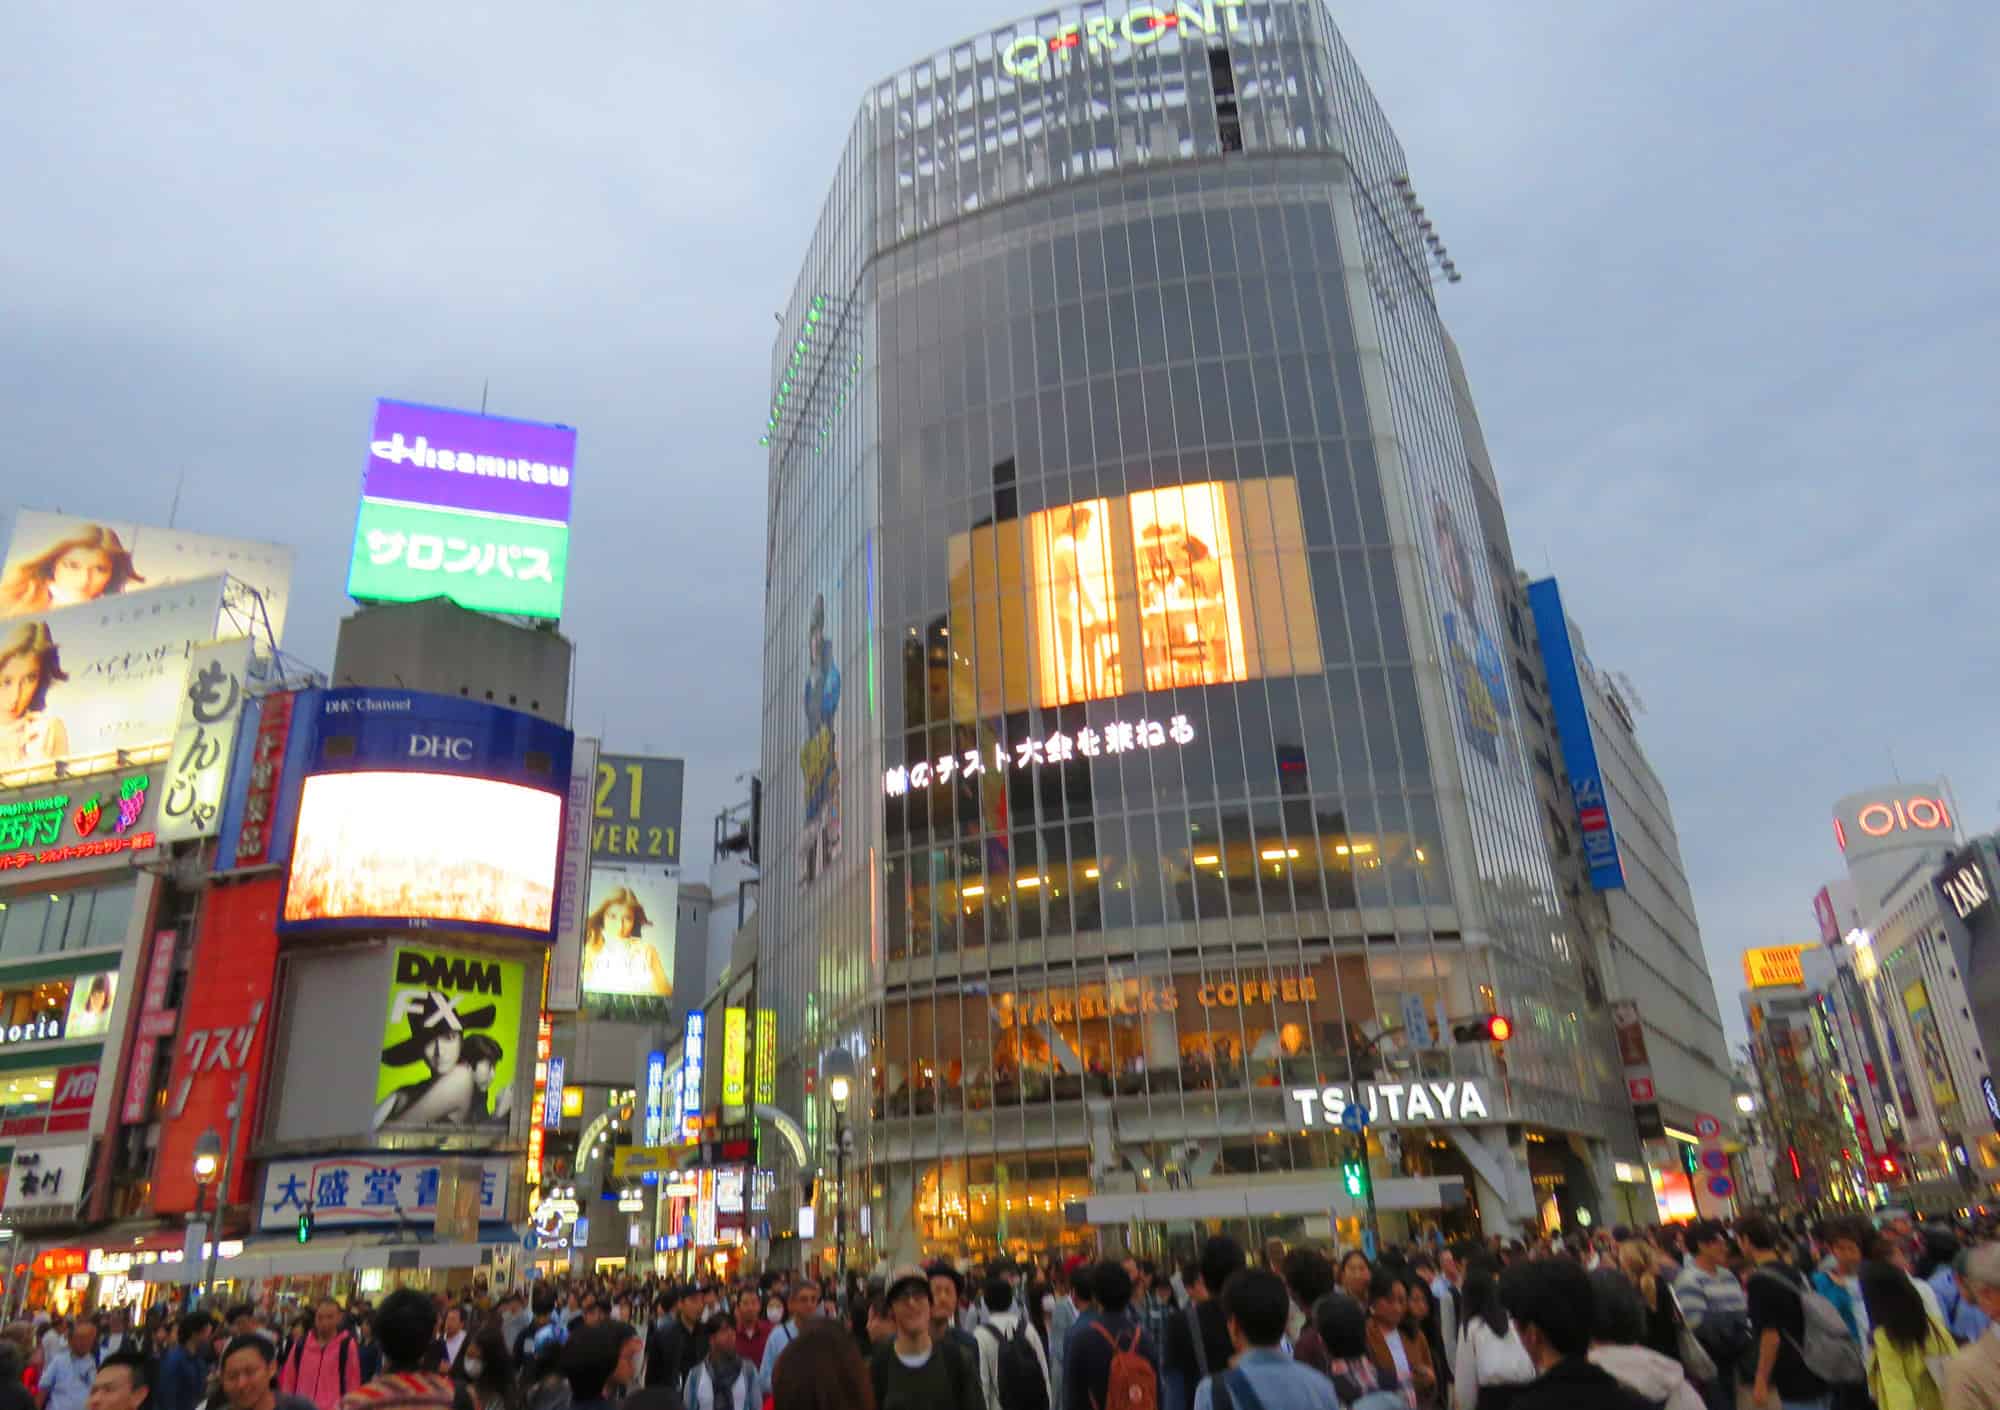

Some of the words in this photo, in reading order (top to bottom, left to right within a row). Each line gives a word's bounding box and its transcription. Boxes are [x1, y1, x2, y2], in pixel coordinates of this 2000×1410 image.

[370, 432, 570, 487] Hisamitsu
[366, 529, 553, 583] サロンパス
[356, 698, 411, 712] Channel
[166, 660, 239, 829] もんじゃ
[408, 733, 474, 761] DHC
[648, 827, 676, 857] 21
[395, 951, 503, 996] DMM
[0, 1014, 59, 1043] oria
[391, 989, 464, 1031] FX
[184, 1027, 256, 1072] クスリ
